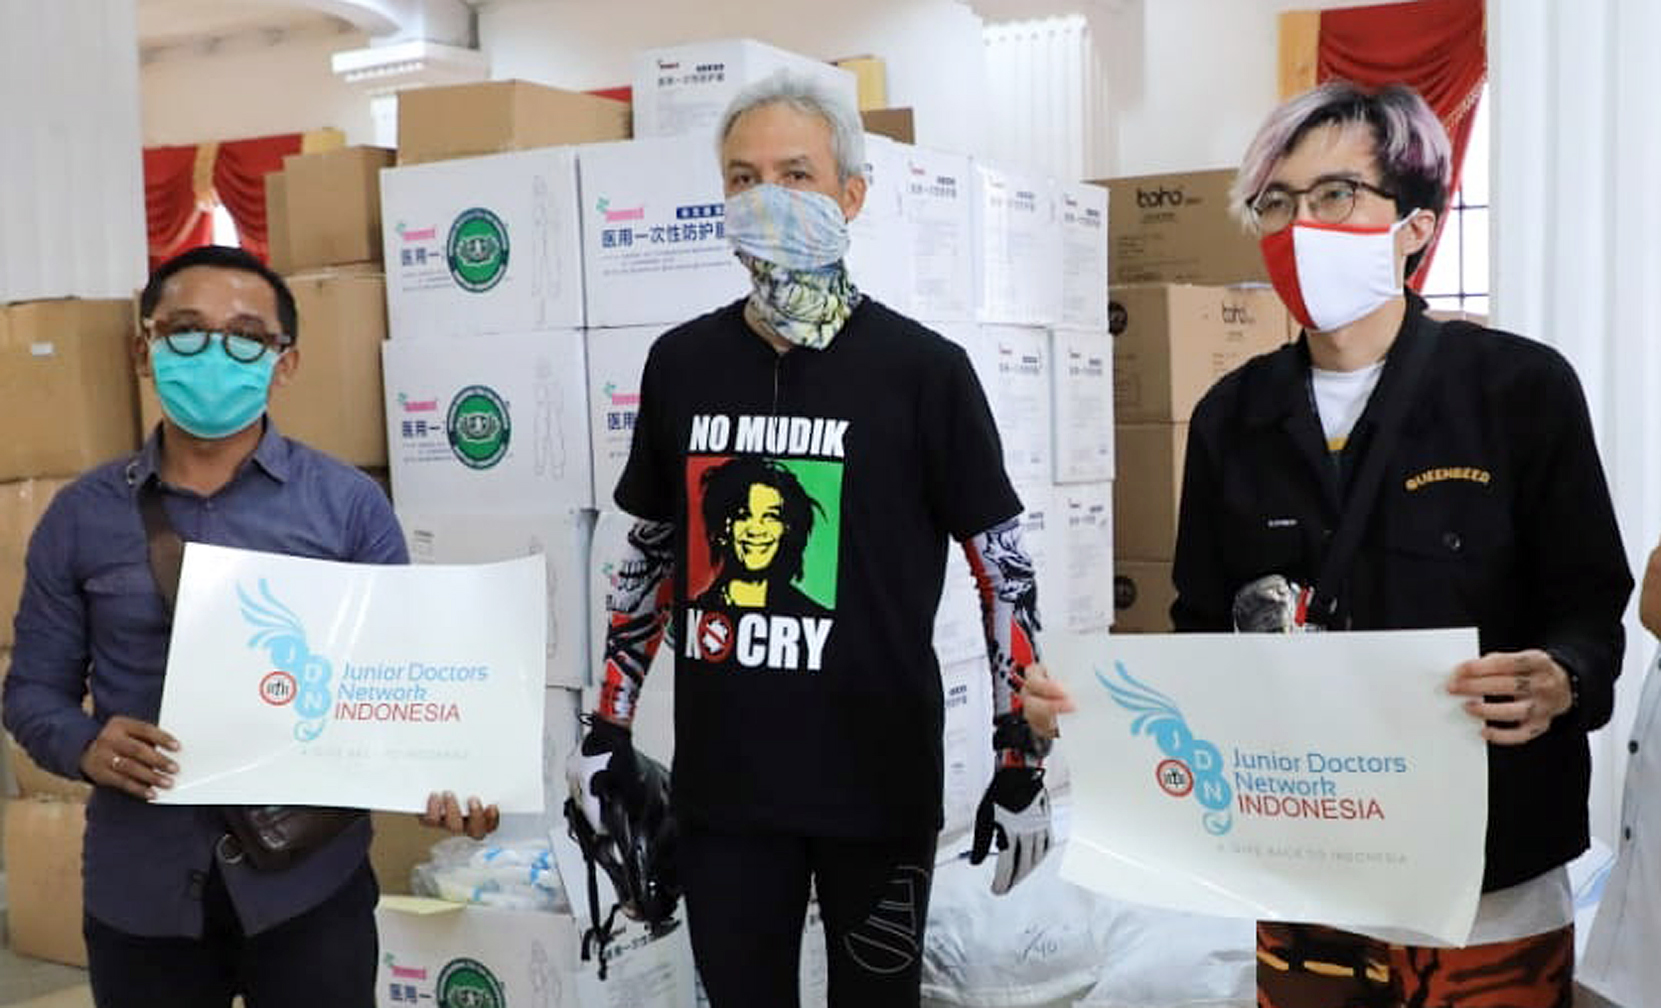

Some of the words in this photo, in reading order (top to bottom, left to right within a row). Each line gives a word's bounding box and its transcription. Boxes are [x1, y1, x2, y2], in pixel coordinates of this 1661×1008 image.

[403, 420, 448, 440] 医用一
[690, 415, 730, 451] NO
[735, 415, 850, 458] MUDIK
[736, 613, 833, 670] CRY
[342, 661, 406, 682] Junior
[408, 662, 490, 682] Doctors
[337, 682, 428, 702] Network
[335, 703, 461, 723] INDONESIA
[1233, 748, 1300, 772] Junior
[1307, 753, 1407, 774] Doctors
[1235, 772, 1337, 797] Network
[1237, 793, 1386, 820] INDONESIA
